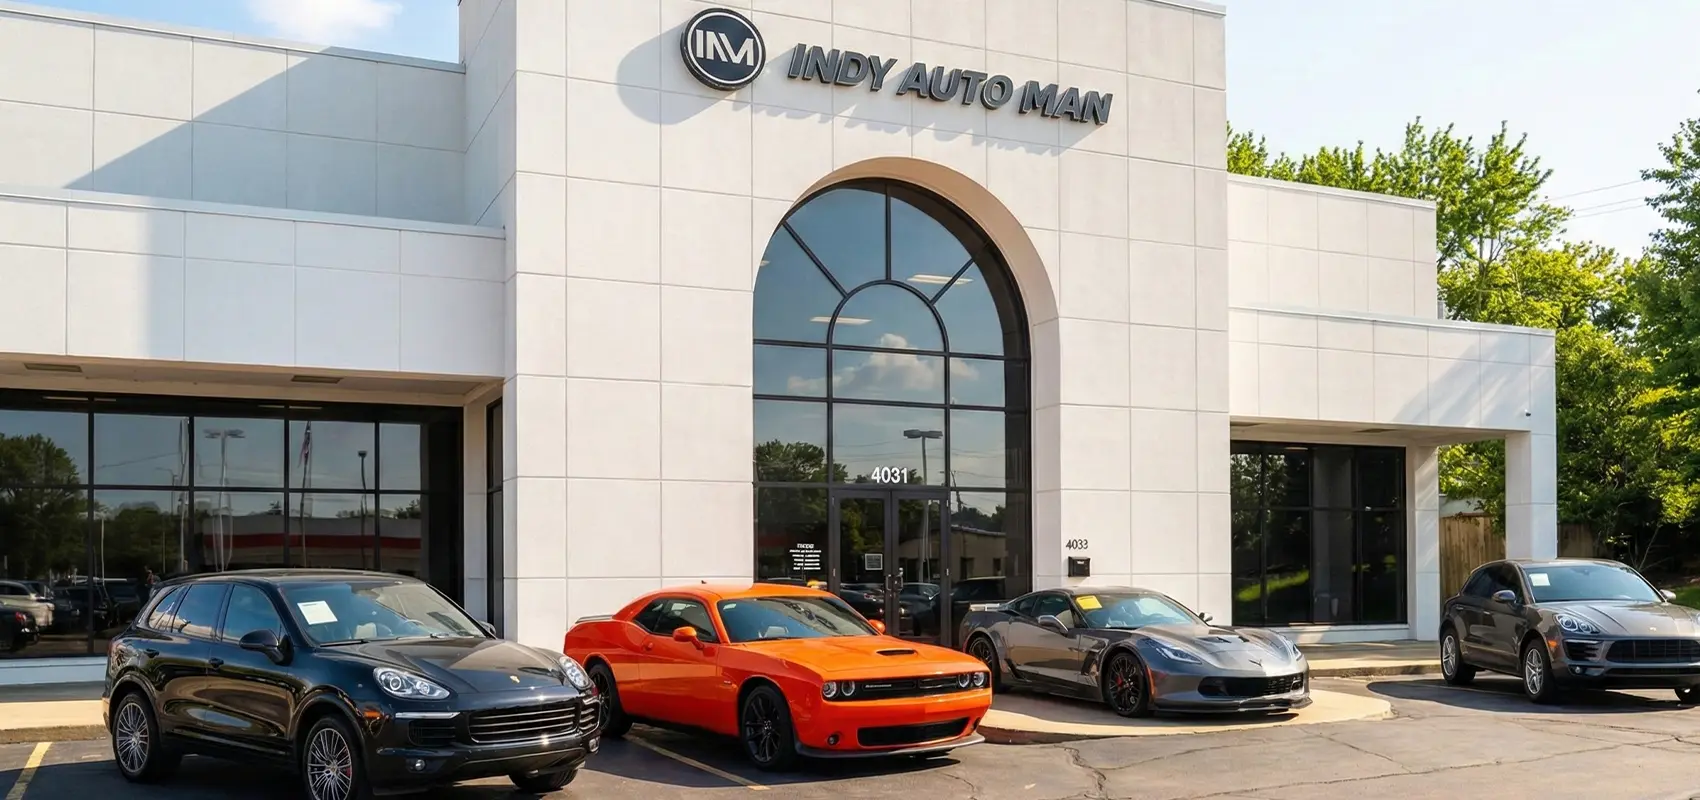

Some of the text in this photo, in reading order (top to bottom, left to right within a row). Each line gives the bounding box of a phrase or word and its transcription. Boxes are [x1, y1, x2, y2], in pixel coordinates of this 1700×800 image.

[788, 43, 1114, 125] INDY AUTO MAN
[871, 466, 909, 484] 4031
[1066, 539, 1089, 550] 4033
